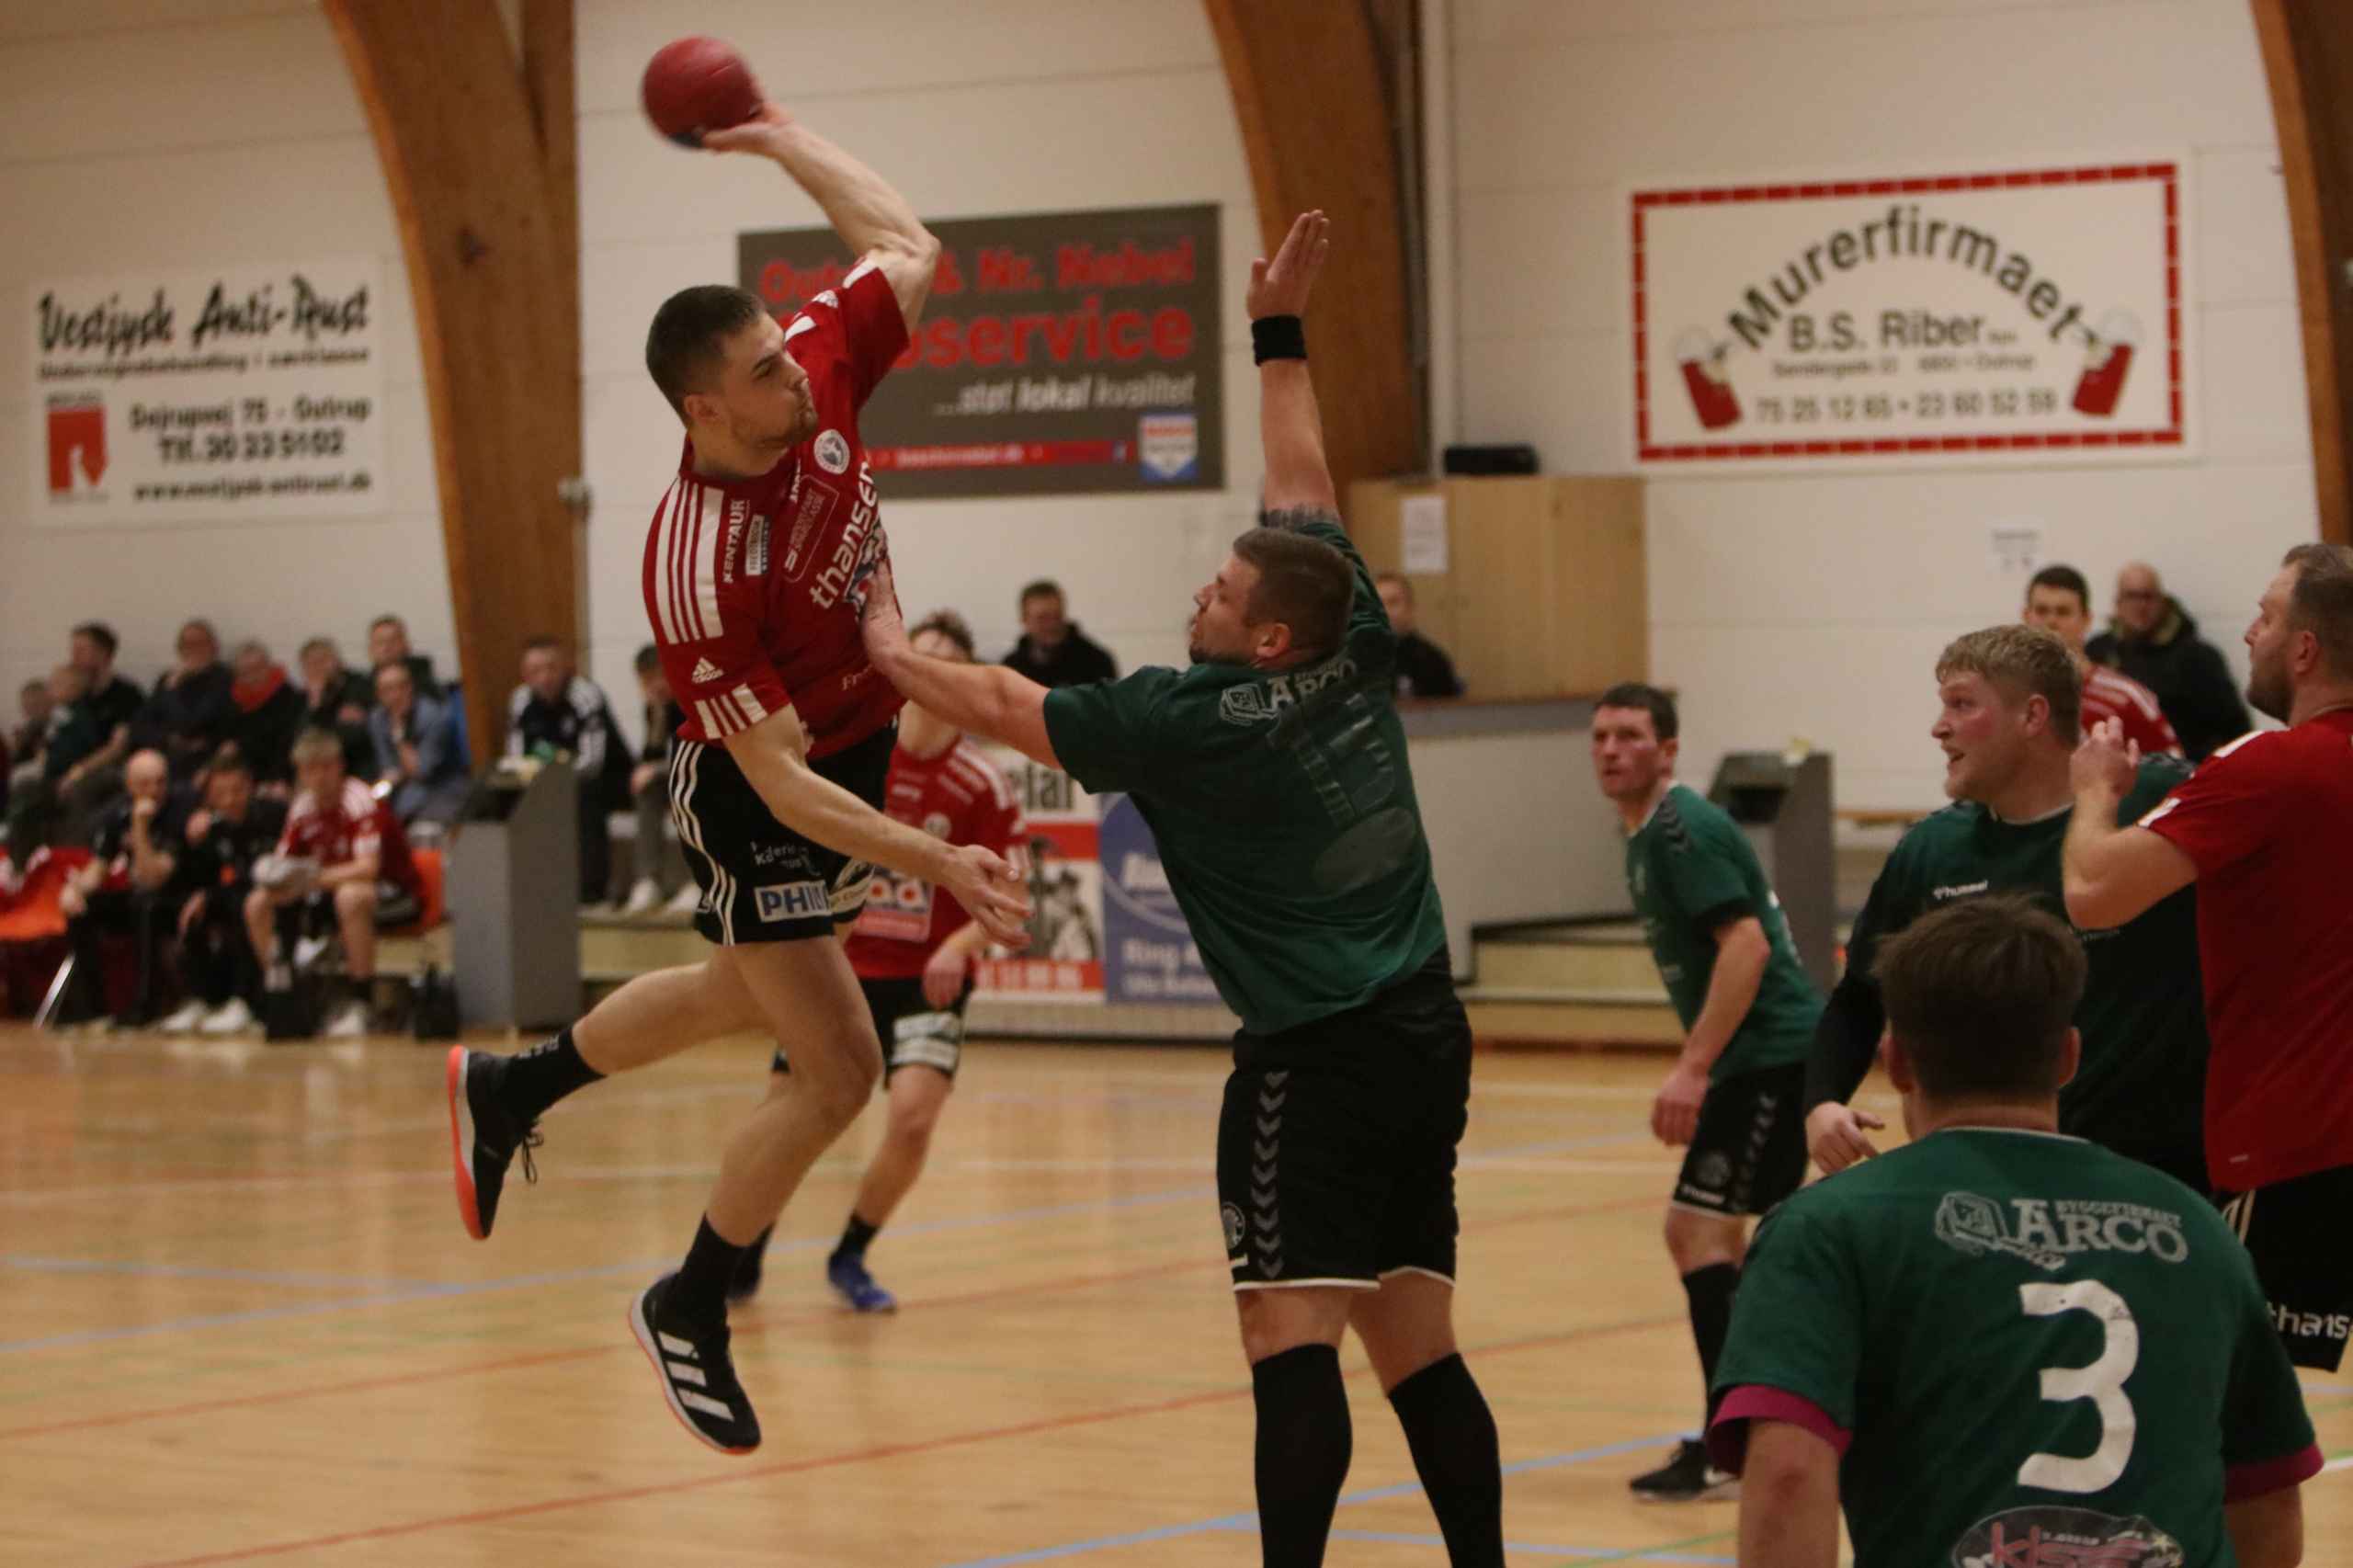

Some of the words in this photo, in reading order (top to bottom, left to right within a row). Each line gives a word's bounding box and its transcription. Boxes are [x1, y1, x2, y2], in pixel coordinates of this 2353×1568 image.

[1728, 204, 2082, 349] Murerfirmaet
[38, 287, 176, 357] Vestjysk
[893, 294, 1192, 369] service
[1788, 313, 1867, 353] B.S.
[1881, 309, 1985, 346] Riber
[1017, 375, 1092, 411] lokal
[722, 500, 745, 583] KENTAUR
[2010, 1198, 2188, 1263] ARCO
[2018, 1278, 2140, 1494] 3
